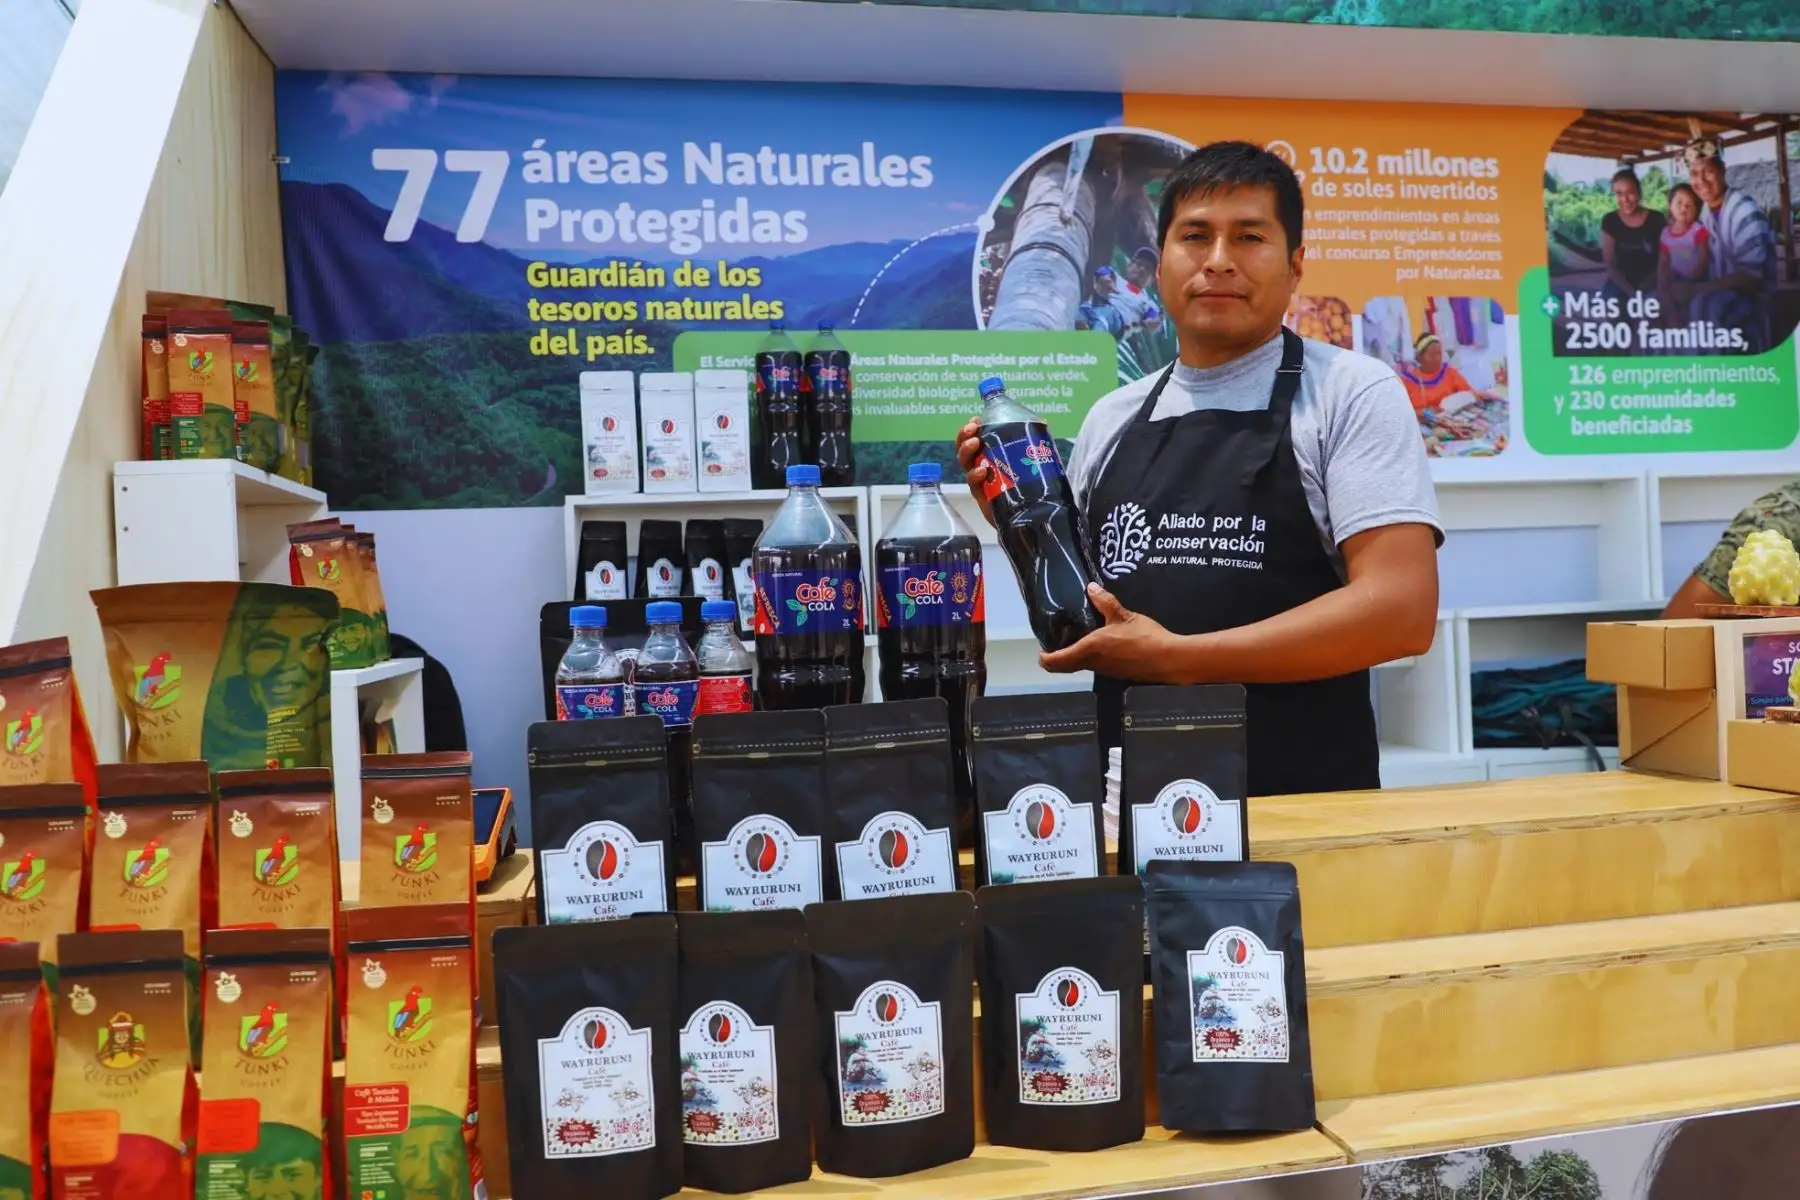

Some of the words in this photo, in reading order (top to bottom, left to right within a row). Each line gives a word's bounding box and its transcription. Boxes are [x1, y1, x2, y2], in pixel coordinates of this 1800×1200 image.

[522, 138, 669, 185] áreas
[684, 141, 934, 188] Naturales
[1310, 147, 1369, 175] 10.2
[1377, 149, 1499, 178] millones
[371, 148, 511, 243] 77
[1311, 177, 1337, 198] de
[1343, 178, 1395, 199] soles
[1400, 180, 1498, 201] invertidos
[1315, 208, 1438, 225] emprendimientos
[1442, 212, 1460, 223] en
[1463, 207, 1500, 224] áreas
[526, 198, 809, 255] Protegidas
[1370, 227, 1443, 244] protegidas
[1447, 231, 1456, 242] a
[1459, 228, 1502, 243] través
[1326, 247, 1390, 260] concurso
[1394, 246, 1503, 263] Emprendedores
[527, 259, 666, 288] Guardián
[673, 260, 710, 287] de
[717, 260, 761, 288] los
[1396, 267, 1420, 283] por
[1424, 265, 1504, 281] Naturaleza.
[528, 297, 638, 323] tesoros
[646, 296, 784, 321] naturales
[1564, 291, 1620, 319] Más
[1626, 290, 1660, 318] de
[530, 328, 579, 357] del
[587, 327, 656, 361] país.
[1565, 322, 1632, 349] 2500
[1638, 320, 1750, 352] familias,
[700, 355, 712, 369] El
[715, 355, 756, 369] Servic
[888, 353, 949, 366] Naturales
[952, 353, 1016, 368] Protegidas
[1019, 355, 1041, 368] por
[1043, 353, 1055, 365] el
[1056, 353, 1098, 366] Estado
[856, 370, 938, 382] conservación
[941, 370, 956, 381] de
[960, 372, 979, 382] sus
[1048, 368, 1089, 383] verdes,
[1569, 364, 1606, 386] 126
[1612, 363, 1781, 389] emprendimientos,
[1004, 384, 1059, 400] gurando
[1061, 385, 1074, 397] la
[864, 402, 936, 415] invaluables
[1026, 401, 1072, 414] entales.
[1554, 394, 1564, 415] y
[1569, 391, 1606, 410] 230
[1610, 389, 1737, 409] comunidades
[1571, 415, 1693, 436] beneficiadas
[1158, 513, 1206, 530] Aliado
[1213, 515, 1243, 532] por
[1252, 515, 1266, 532] la
[1155, 534, 1265, 553] conservación
[1147, 556, 1168, 565] AREA
[1170, 556, 1208, 566] NATURAL
[1212, 557, 1263, 570] PROTEGIDA
[808, 602, 836, 612] COLA
[916, 596, 944, 605] COLA
[952, 612, 962, 620] 2L
[1788, 641, 1800, 653] S
[1008, 848, 1078, 863] WAYRURUNI
[1154, 844, 1224, 856] WAYRURUNI
[1034, 862, 1056, 872] Café
[391, 872, 440, 888] TUNKI
[862, 876, 936, 894] WAYRURUNI
[119, 886, 168, 904] TUNKI
[251, 884, 302, 902] TUNKI
[566, 890, 645, 905] WAYRURUNI
[725, 883, 802, 896] WAYRURUNI
[593, 904, 618, 915] Café
[752, 896, 776, 907] Café
[1207, 971, 1270, 980] WAYRURUNI
[1037, 1014, 1103, 1023] WAYRURUNI
[856, 1026, 923, 1040] WAYRURUNI
[384, 1040, 436, 1060] TUNKI
[687, 1050, 755, 1060] WAYRURUNI
[234, 1055, 291, 1076] TUNKI
[561, 1054, 633, 1069] WAYRURUNI
